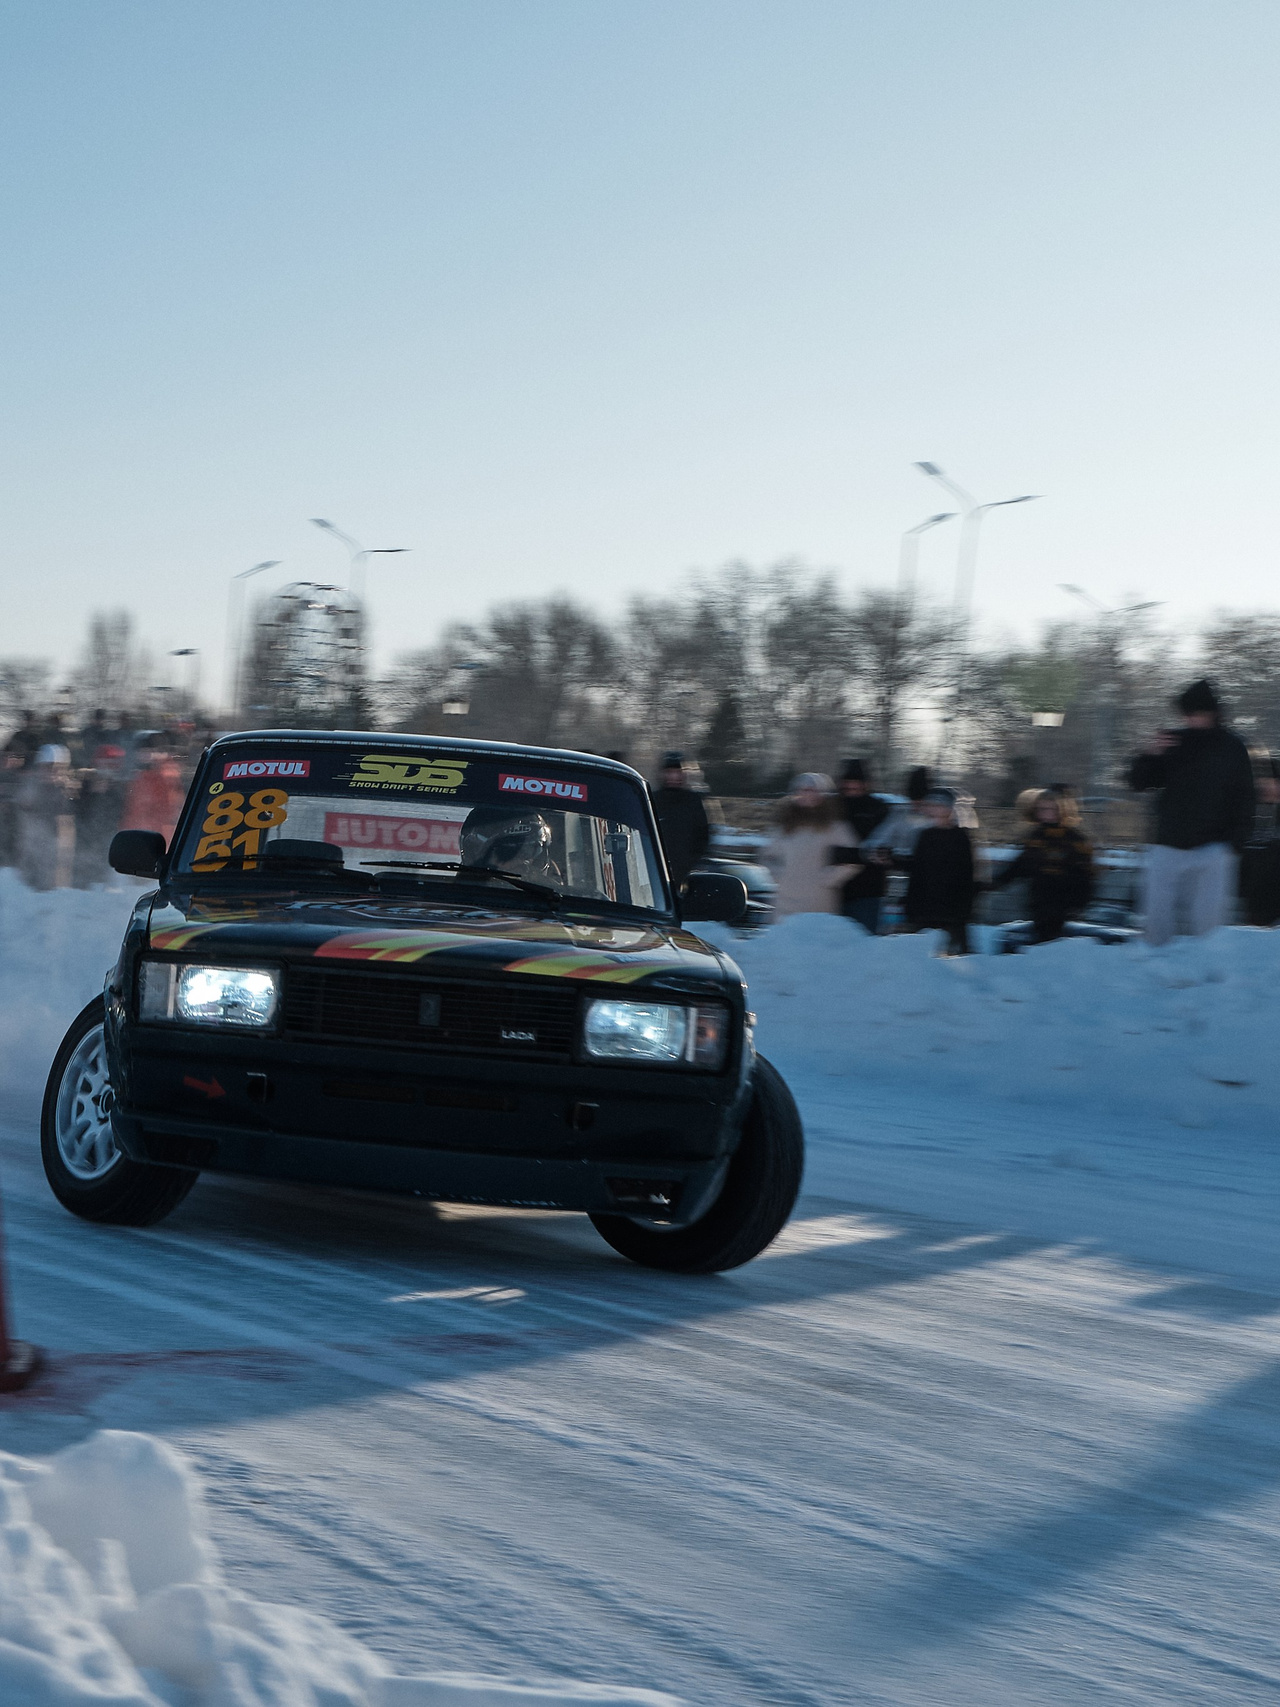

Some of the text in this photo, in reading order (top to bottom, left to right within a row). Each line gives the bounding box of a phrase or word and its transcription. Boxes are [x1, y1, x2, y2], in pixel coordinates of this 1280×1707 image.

[227, 762, 306, 778] MOTUL
[348, 781, 457, 795] SNOW DRIFT SERIES
[502, 776, 584, 799] MOTUL
[202, 788, 289, 834] 88
[191, 829, 261, 873] 51
[502, 1030, 536, 1041] LADA
